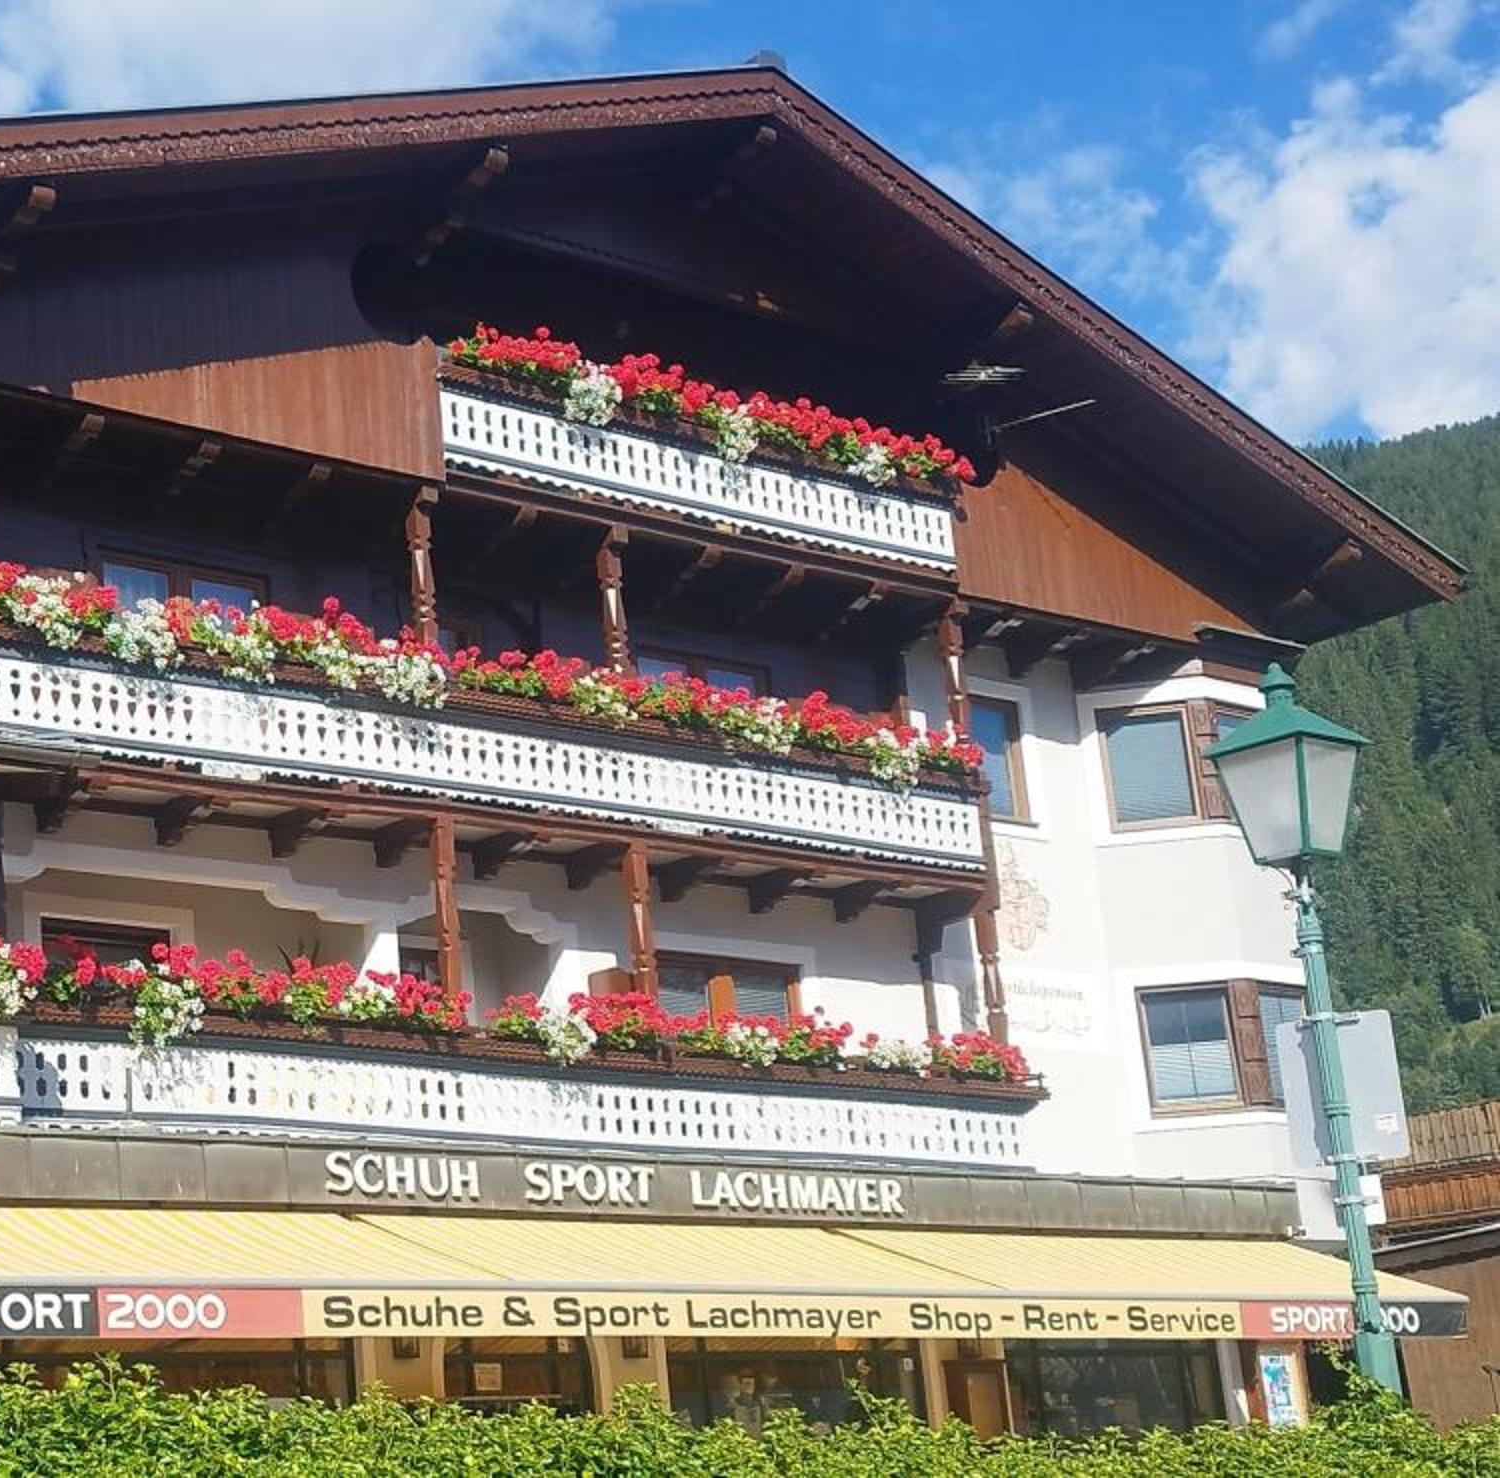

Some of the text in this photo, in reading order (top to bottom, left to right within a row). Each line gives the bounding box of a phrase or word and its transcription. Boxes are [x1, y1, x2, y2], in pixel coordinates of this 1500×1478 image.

[323, 1150, 905, 1215] SCHUH SPORT LACHMAYER
[106, 1293, 229, 1330] 2000
[323, 1295, 484, 1329] Schuhe
[502, 1296, 535, 1327] &
[553, 1297, 670, 1336] Sport
[687, 1299, 882, 1338] Lachmayer
[911, 1303, 993, 1338] Shop
[1023, 1305, 1099, 1331] Rent
[1128, 1306, 1236, 1333] Service
[1271, 1307, 1348, 1333] SPORT
